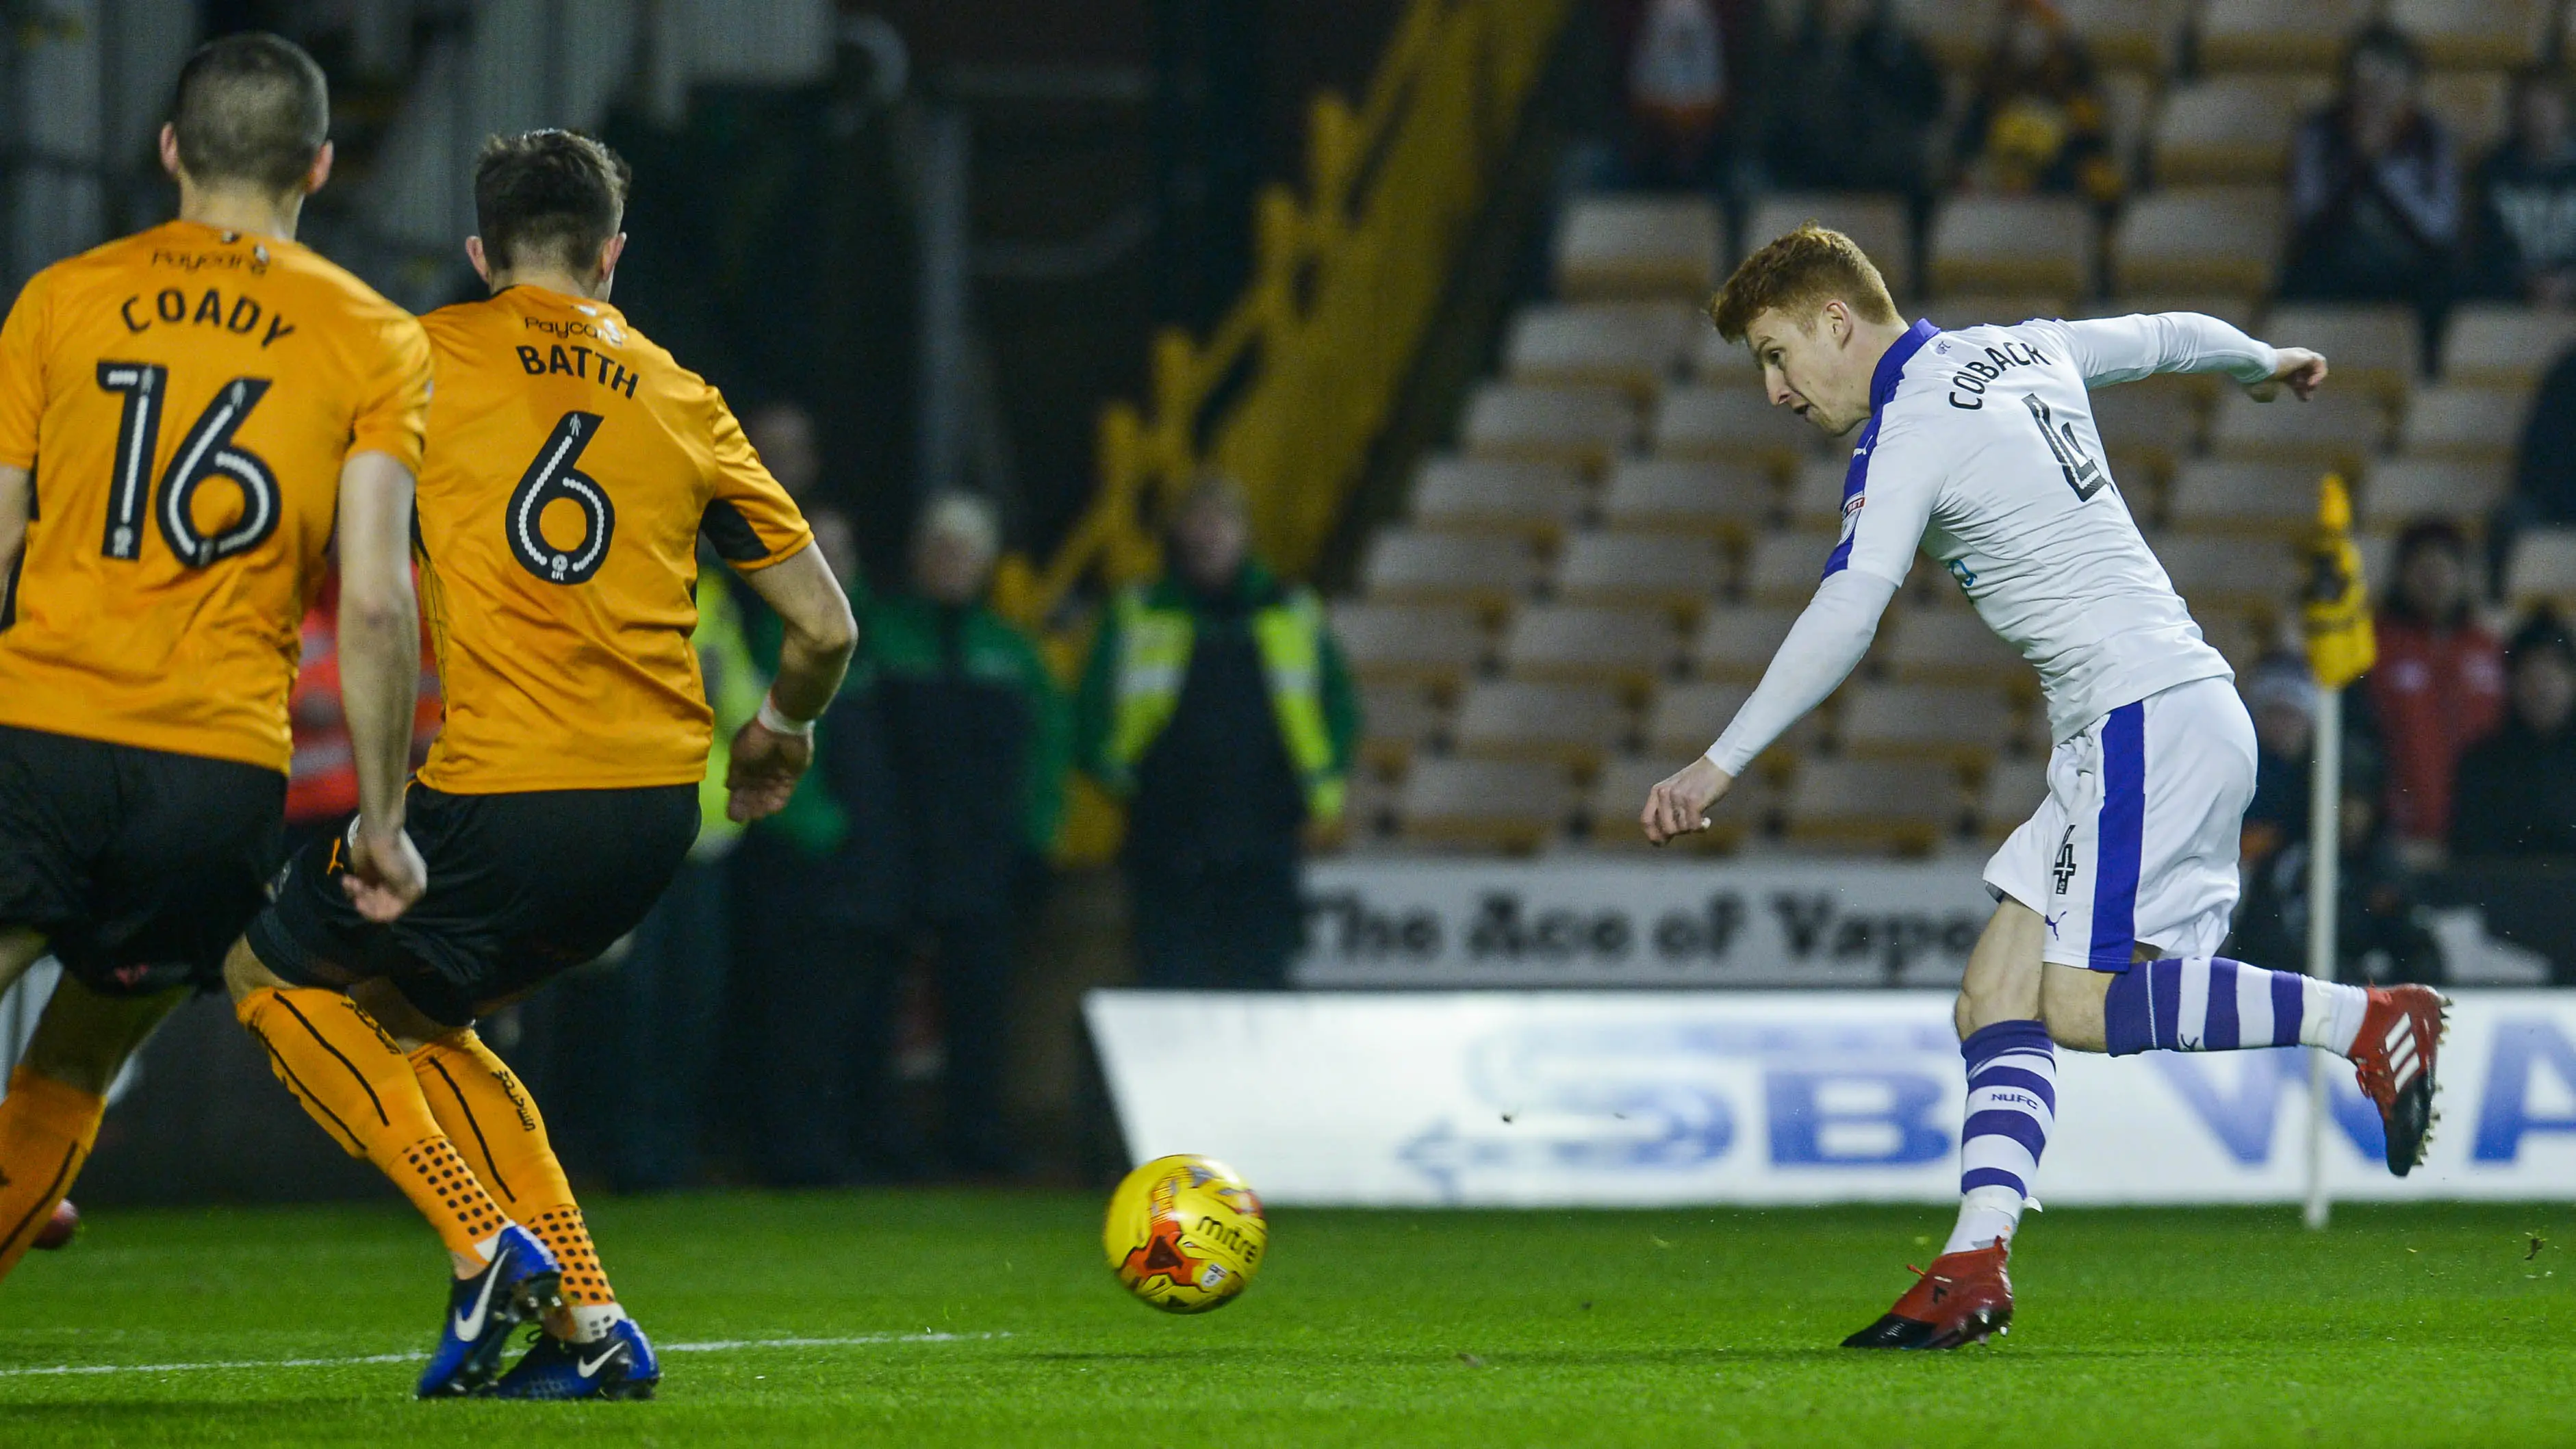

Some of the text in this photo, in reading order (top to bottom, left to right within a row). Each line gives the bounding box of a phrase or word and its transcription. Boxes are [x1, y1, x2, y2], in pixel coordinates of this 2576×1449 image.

[121, 287, 295, 349] COADY
[515, 344, 640, 400] BATTH
[1948, 342, 2052, 411] COLBACK
[97, 359, 282, 569] 16
[505, 410, 616, 586] 6
[2052, 824, 2077, 895] 4
[1650, 888, 1747, 956] of
[1991, 1093, 2038, 1110] NUFC
[1196, 1215, 1258, 1264] mitre
